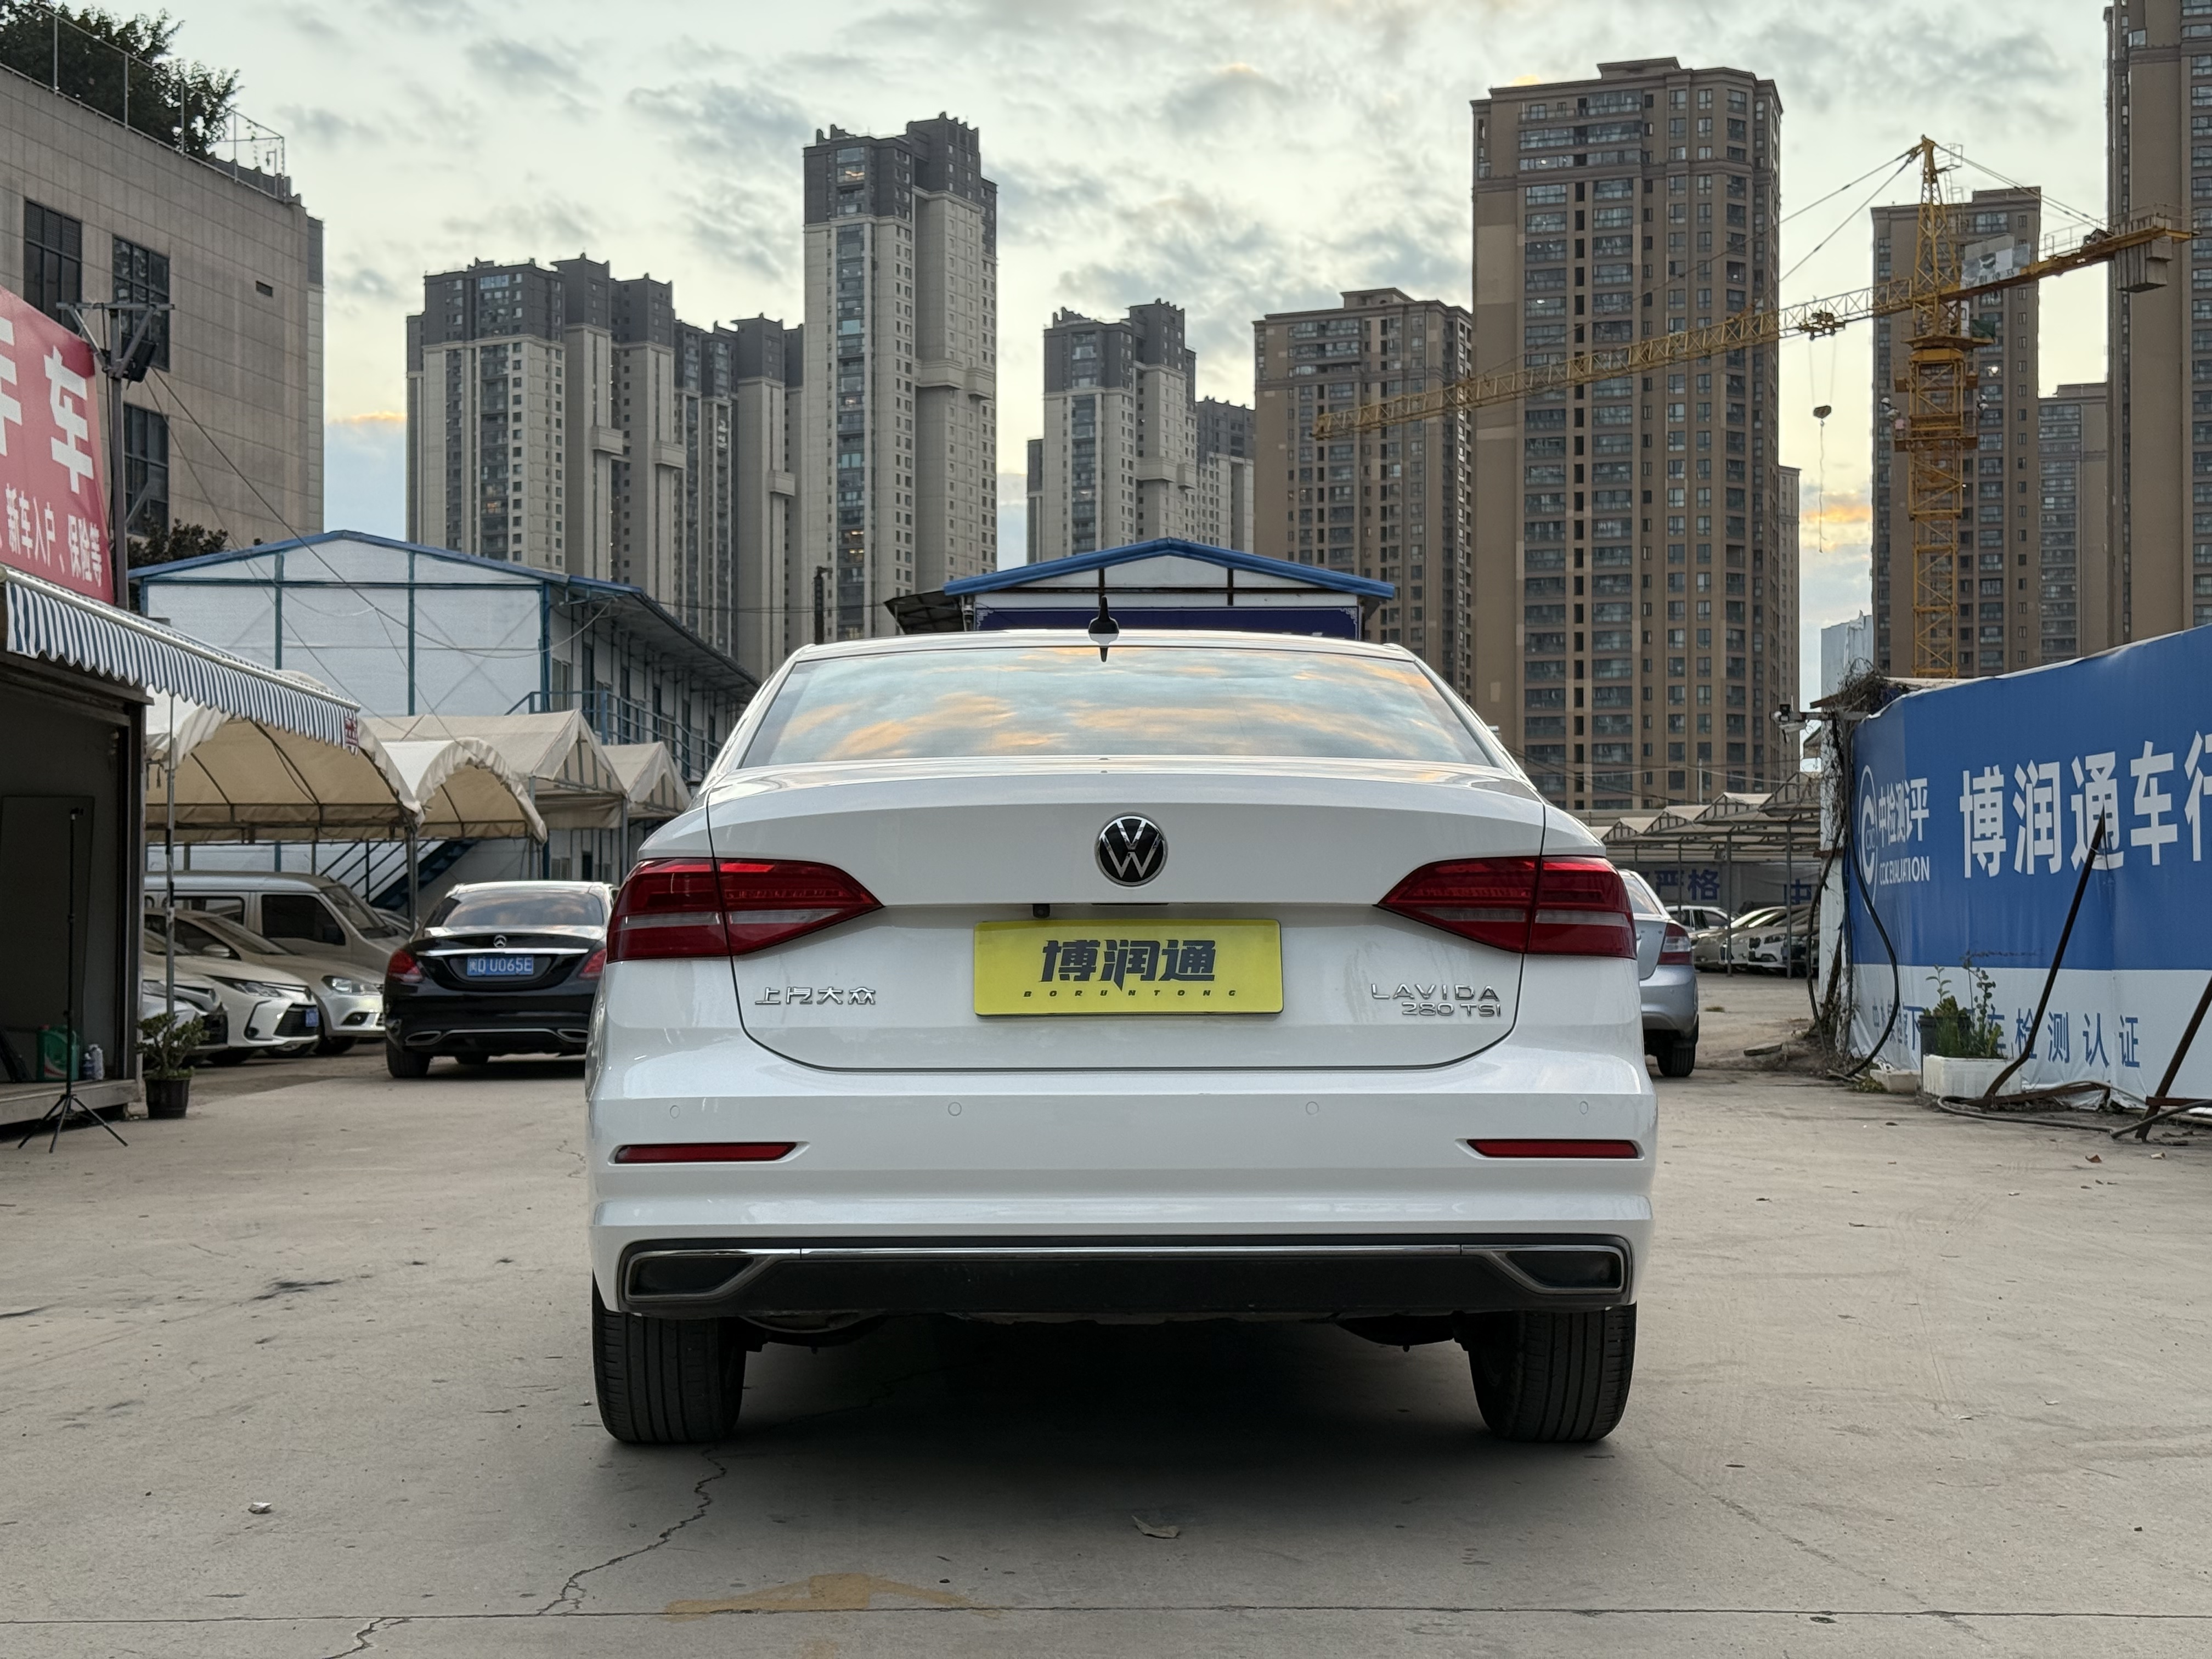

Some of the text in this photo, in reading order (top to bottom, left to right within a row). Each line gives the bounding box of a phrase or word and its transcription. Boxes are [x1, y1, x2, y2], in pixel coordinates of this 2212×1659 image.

[1960, 730, 2212, 878] 博润通车行
[1641, 869, 1720, 901] 严格
[1040, 940, 1216, 992] 博润通
[755, 986, 876, 1005] 上汽大众
[1371, 983, 1500, 1001] LAVIDA
[1401, 1002, 1502, 1017] 280 TSI
